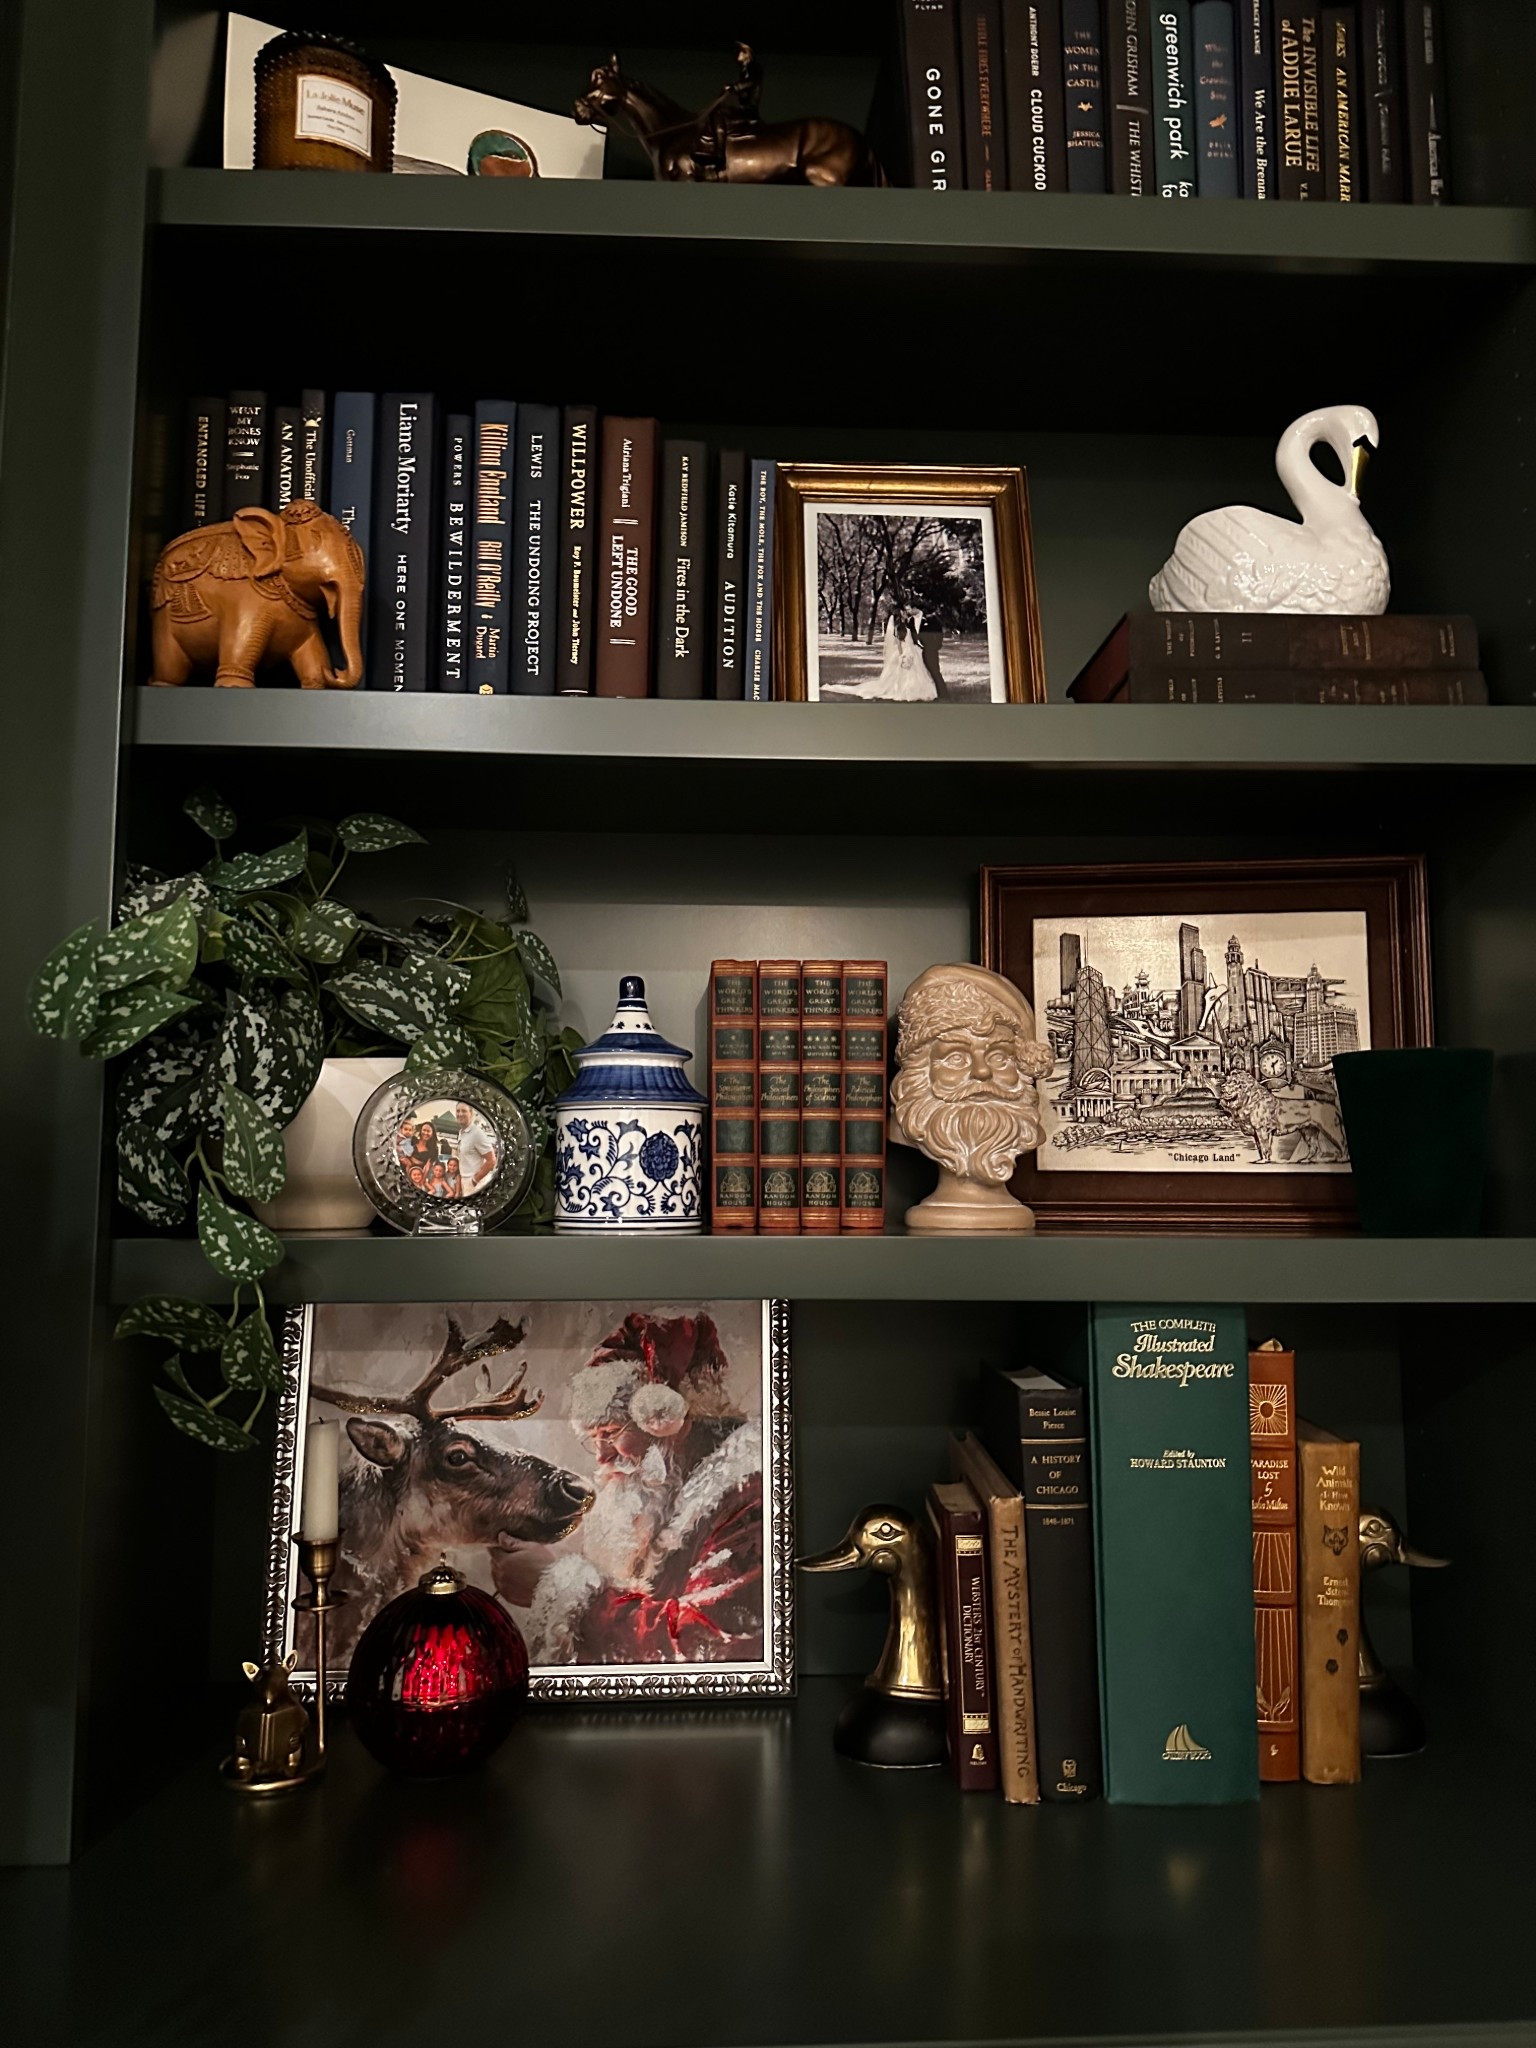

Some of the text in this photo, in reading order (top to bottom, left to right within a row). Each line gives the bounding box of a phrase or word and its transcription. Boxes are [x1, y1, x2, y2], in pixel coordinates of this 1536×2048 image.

[1029, 6, 1040, 77] ANTHONY DOERR
[1074, 31, 1091, 39] THE
[1126, 0, 1138, 96] OHN GRISHAM
[1159, 14, 1189, 160] greenwich park
[1336, 68, 1347, 88] AN
[926, 68, 944, 135] GONE
[1254, 89, 1265, 109] We
[1281, 19, 1302, 168] of ADDIE LARUE
[1302, 17, 1320, 172] The INVISIBLE LIFE
[1255, 111, 1266, 134] Are
[1337, 90, 1350, 161] AMERICAN
[1031, 89, 1046, 191] CLOUD CUCKOO
[1129, 120, 1140, 147] THE
[1067, 140, 1103, 148] SHATTUC
[1256, 136, 1268, 156] the
[228, 406, 261, 416] WHAT
[236, 417, 253, 425] MY
[227, 428, 262, 436] BONES
[280, 421, 293, 441] AN
[228, 438, 261, 446] KNOW
[345, 428, 356, 463] Gottman
[195, 416, 209, 489] ENTANGLED
[453, 437, 463, 486] POWERS
[530, 434, 543, 478] LEWIS
[303, 430, 318, 501] The Unofficial
[390, 402, 418, 535] Liane Moriarty
[477, 423, 509, 525] Killing England
[619, 438, 633, 508] Adriana Trigiani
[234, 473, 250, 481] Foo
[570, 424, 588, 530] WILLPOWER
[760, 470, 768, 485] THE
[194, 493, 206, 517] LIFE
[679, 456, 690, 547] KAY REDFIELD JAMISON
[726, 484, 738, 559] Katie Kitamura
[477, 540, 503, 561] Bill
[572, 545, 582, 560] Roy
[757, 548, 765, 563] THE
[609, 535, 625, 628] LEFT UNDONE
[625, 547, 639, 617] THE GOOD
[757, 564, 765, 580] FOX
[395, 554, 408, 631] HERE ONE
[446, 502, 464, 680] BEWILDERMENT
[474, 563, 502, 608] O'Reilly
[524, 499, 542, 676] THE UNDOING PROJECT
[756, 581, 764, 599] AND
[674, 557, 691, 659] Fires in the Dark
[755, 601, 763, 616] THE
[571, 619, 581, 637] John
[722, 581, 736, 668] AUDITION
[488, 627, 501, 659] Martin
[764, 988, 798, 996] WORLD'S
[767, 997, 793, 1005] GREAT
[806, 988, 840, 996] WORLD'S
[809, 997, 835, 1005] GREAT
[812, 1075, 830, 1085] The
[1168, 1153, 1241, 1163] "Chicago Land"
[1131, 1319, 1217, 1333] THE COMPLETE
[1133, 1334, 1216, 1353] Illustrated
[1112, 1354, 1235, 1388] Shakespeare
[1029, 1408, 1077, 1417] Bessie Louise
[1043, 1421, 1065, 1429] Pierce
[1031, 1454, 1081, 1464] A HISTORY
[1130, 1458, 1227, 1469] HOWARD STAUNTON
[1163, 1450, 1196, 1459] Edited by
[1049, 1471, 1062, 1479] OF
[1258, 1471, 1281, 1479] LOST
[1321, 1465, 1346, 1476] Wild
[1036, 1486, 1079, 1495] CHICAGO
[1316, 1477, 1353, 1488] Animals
[1320, 1501, 1350, 1511] Known
[1001, 1525, 1019, 1558] THE
[1003, 1560, 1023, 1644] MYSTERY
[962, 1604, 974, 1664] DICTIONARY
[974, 1647, 987, 1693] CENTURY
[1009, 1662, 1032, 1779] HANDWRITING
[1056, 1782, 1087, 1794] Chicago
